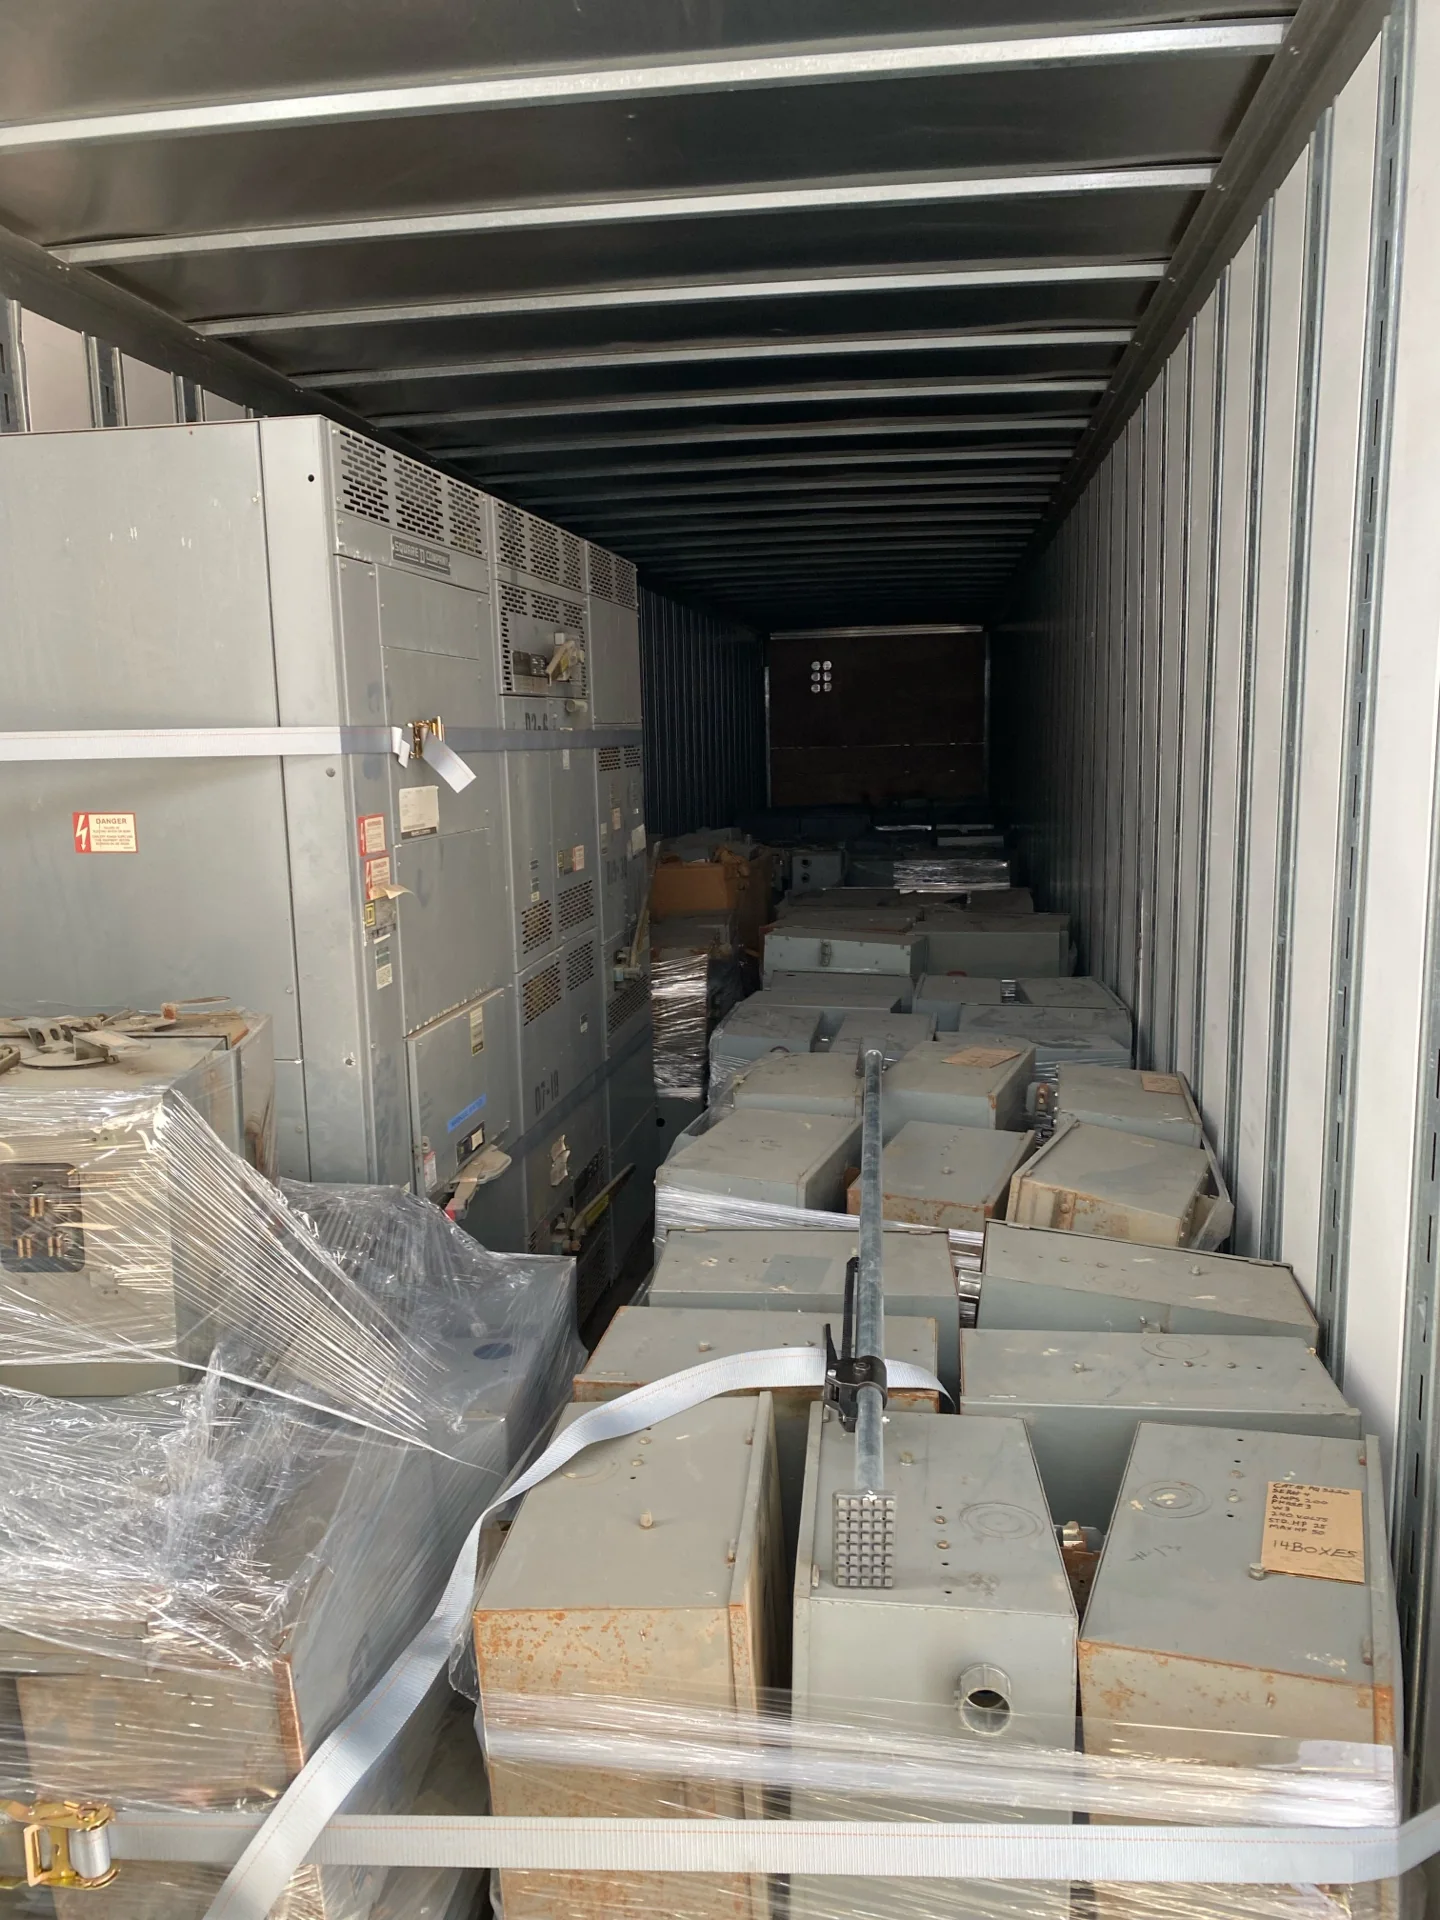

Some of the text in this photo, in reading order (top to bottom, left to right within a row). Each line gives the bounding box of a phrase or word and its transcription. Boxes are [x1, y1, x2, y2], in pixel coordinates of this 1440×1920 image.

[394, 541, 419, 557] SQUARE
[1271, 1494, 1300, 1503] AMPS
[1271, 1499, 1304, 1508] PHASE
[1296, 1514, 1329, 1523] VOLTS
[1292, 1520, 1307, 1528] HP
